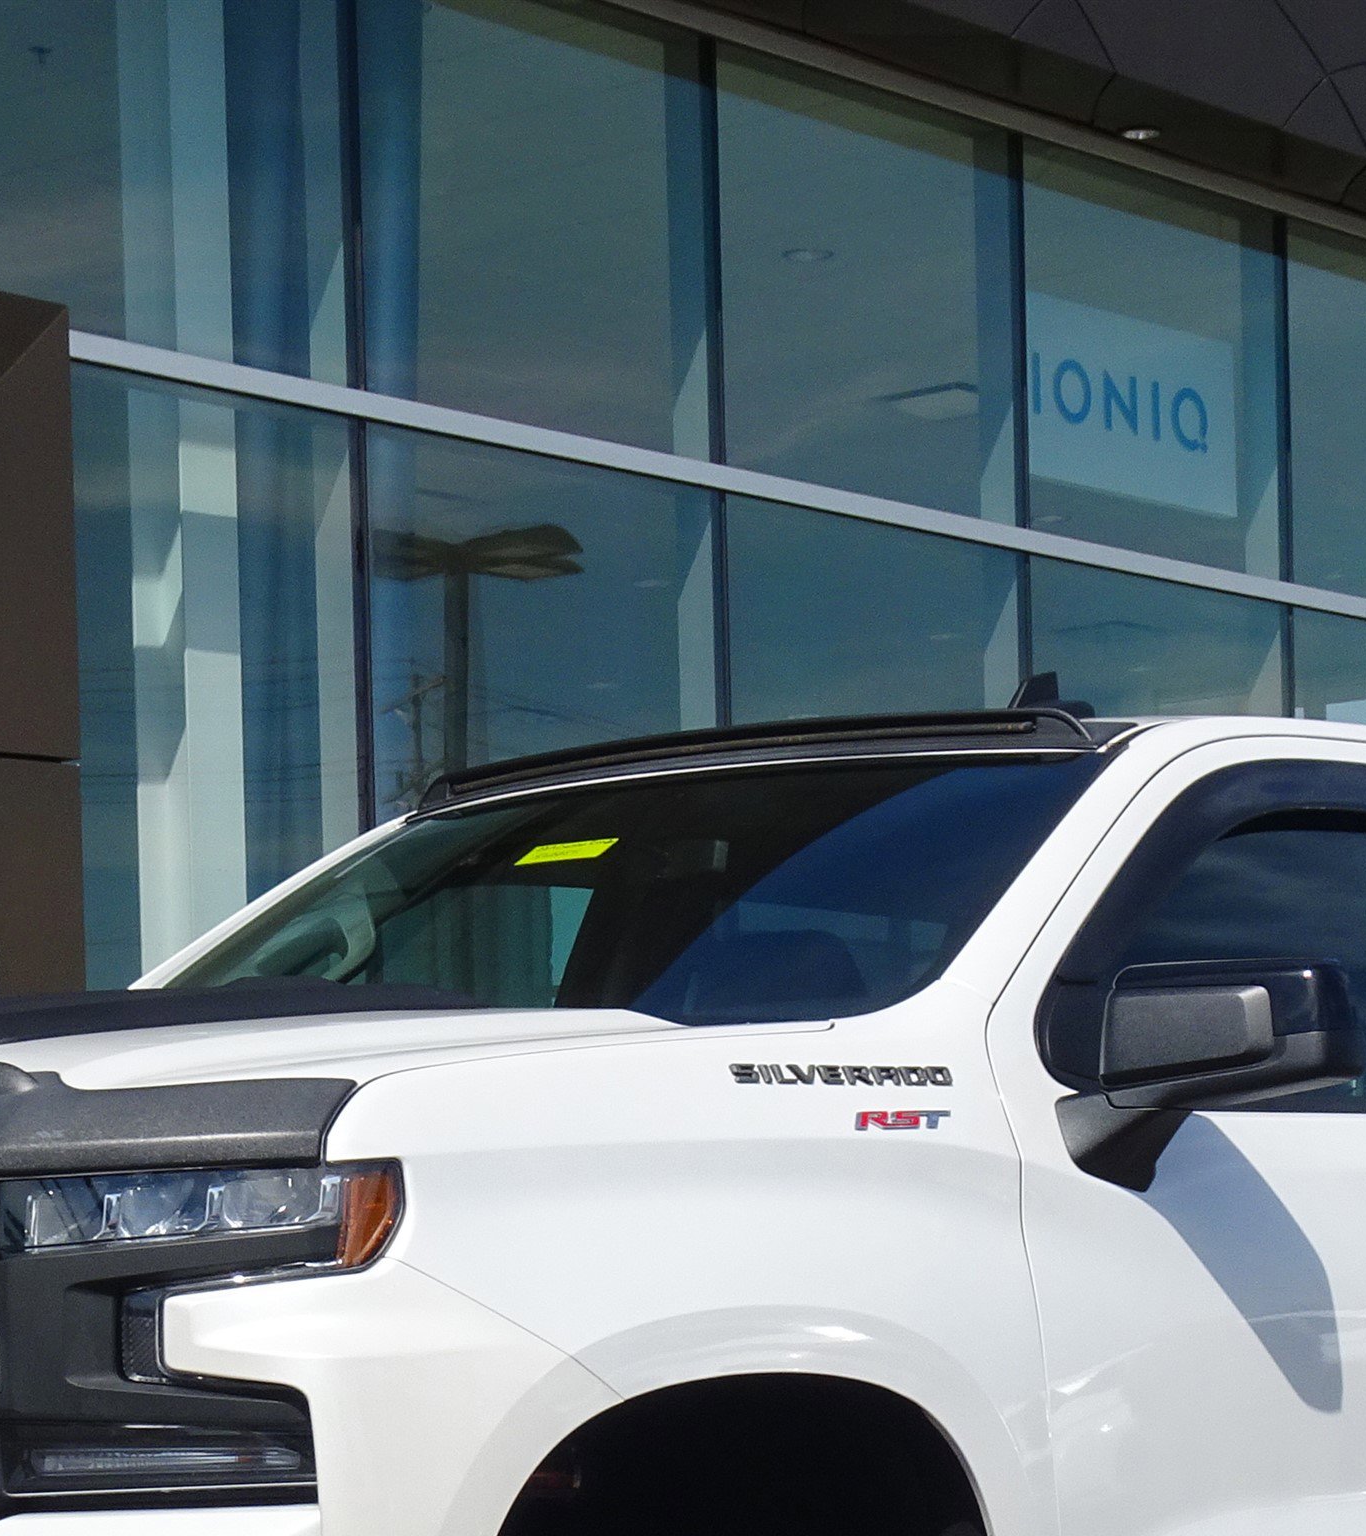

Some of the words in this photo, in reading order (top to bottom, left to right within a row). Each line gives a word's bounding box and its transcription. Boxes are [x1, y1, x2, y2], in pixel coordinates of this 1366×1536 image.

[1030, 351, 1209, 454] IONIQ
[728, 1062, 954, 1087] SILVERADO
[854, 1110, 951, 1131] RST
